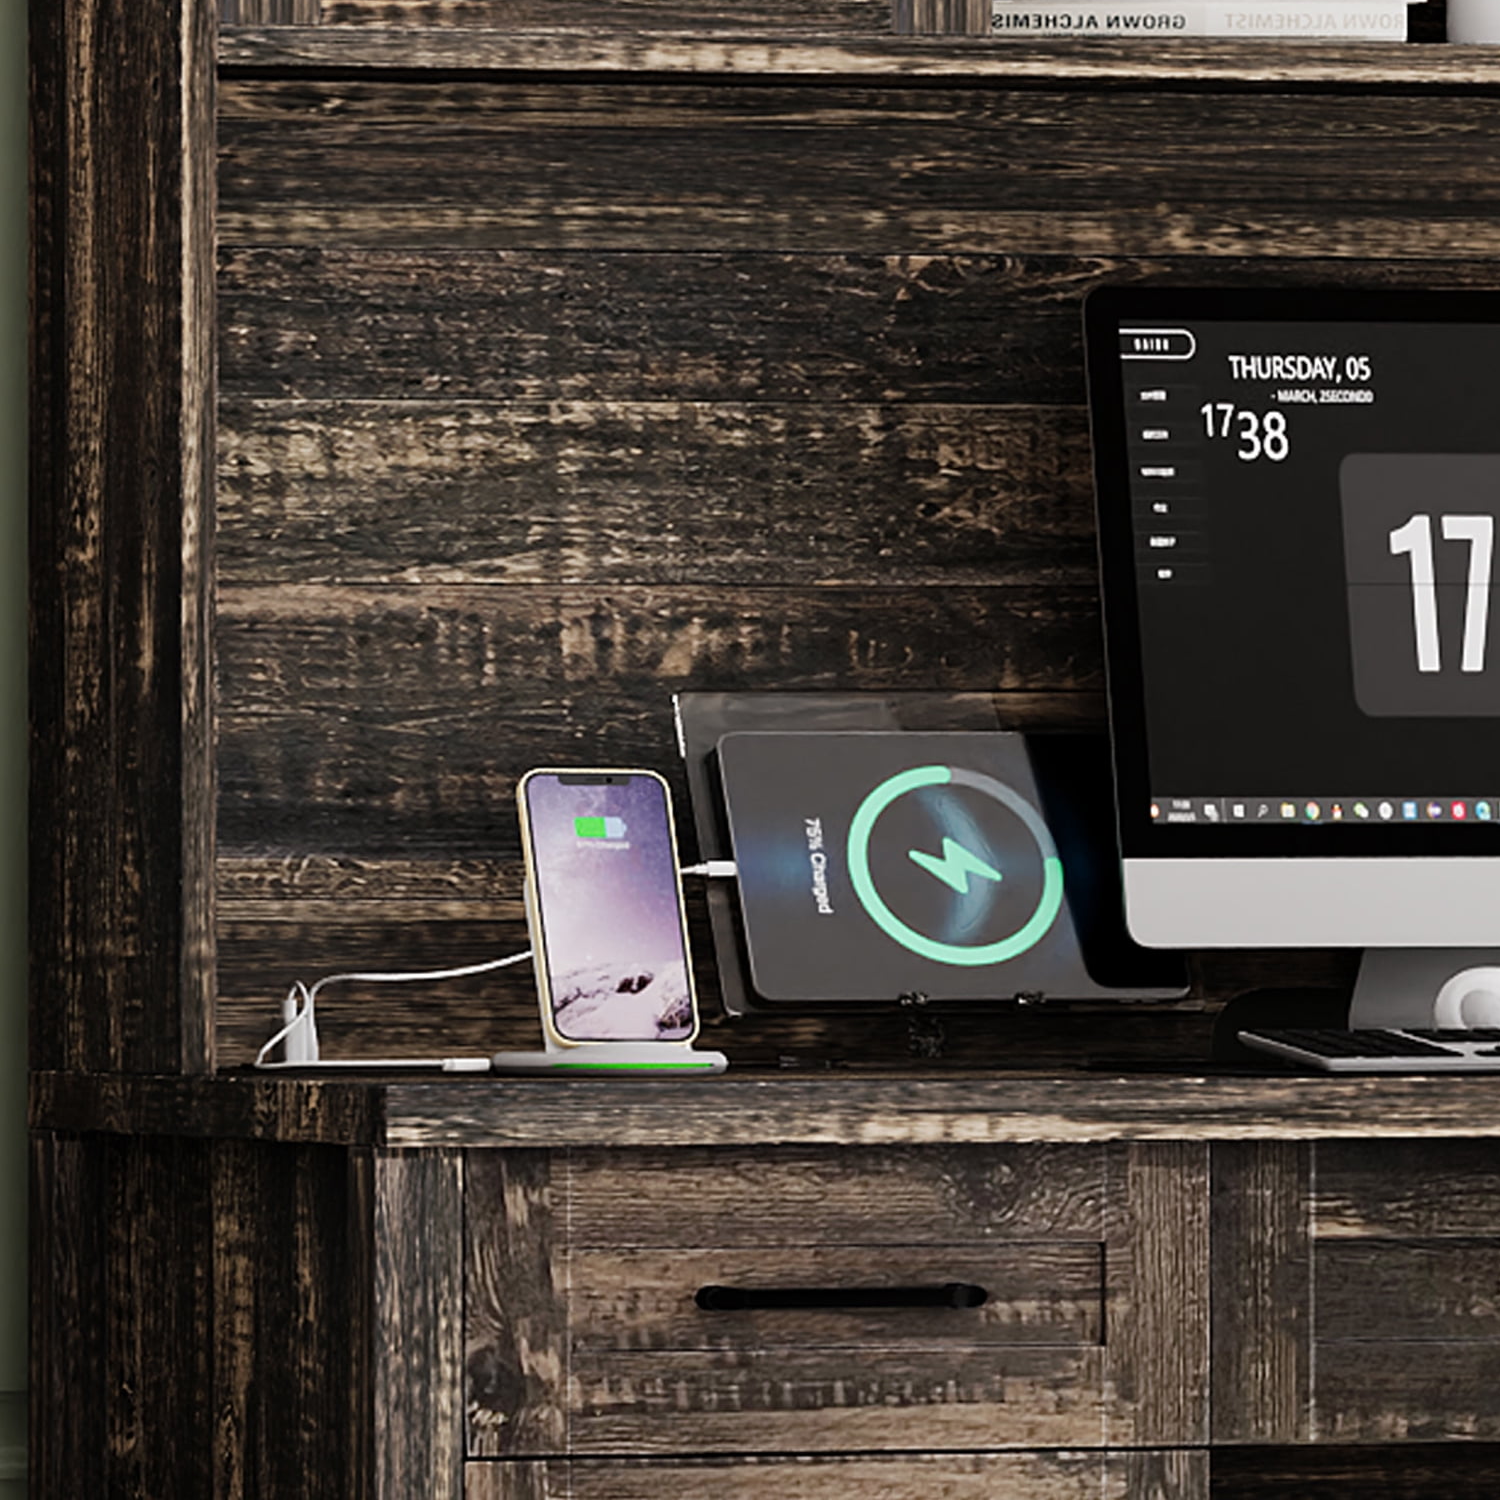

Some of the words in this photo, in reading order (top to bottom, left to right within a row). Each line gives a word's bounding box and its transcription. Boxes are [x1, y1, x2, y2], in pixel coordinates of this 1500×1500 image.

[1228, 355, 1342, 383] THURSDAY,
[1346, 356, 1371, 380] 05
[1201, 403, 1235, 438] 17
[1237, 410, 1289, 460] 38
[1390, 514, 1494, 672] 17
[805, 818, 822, 850] 75%
[810, 852, 834, 914] Charged
